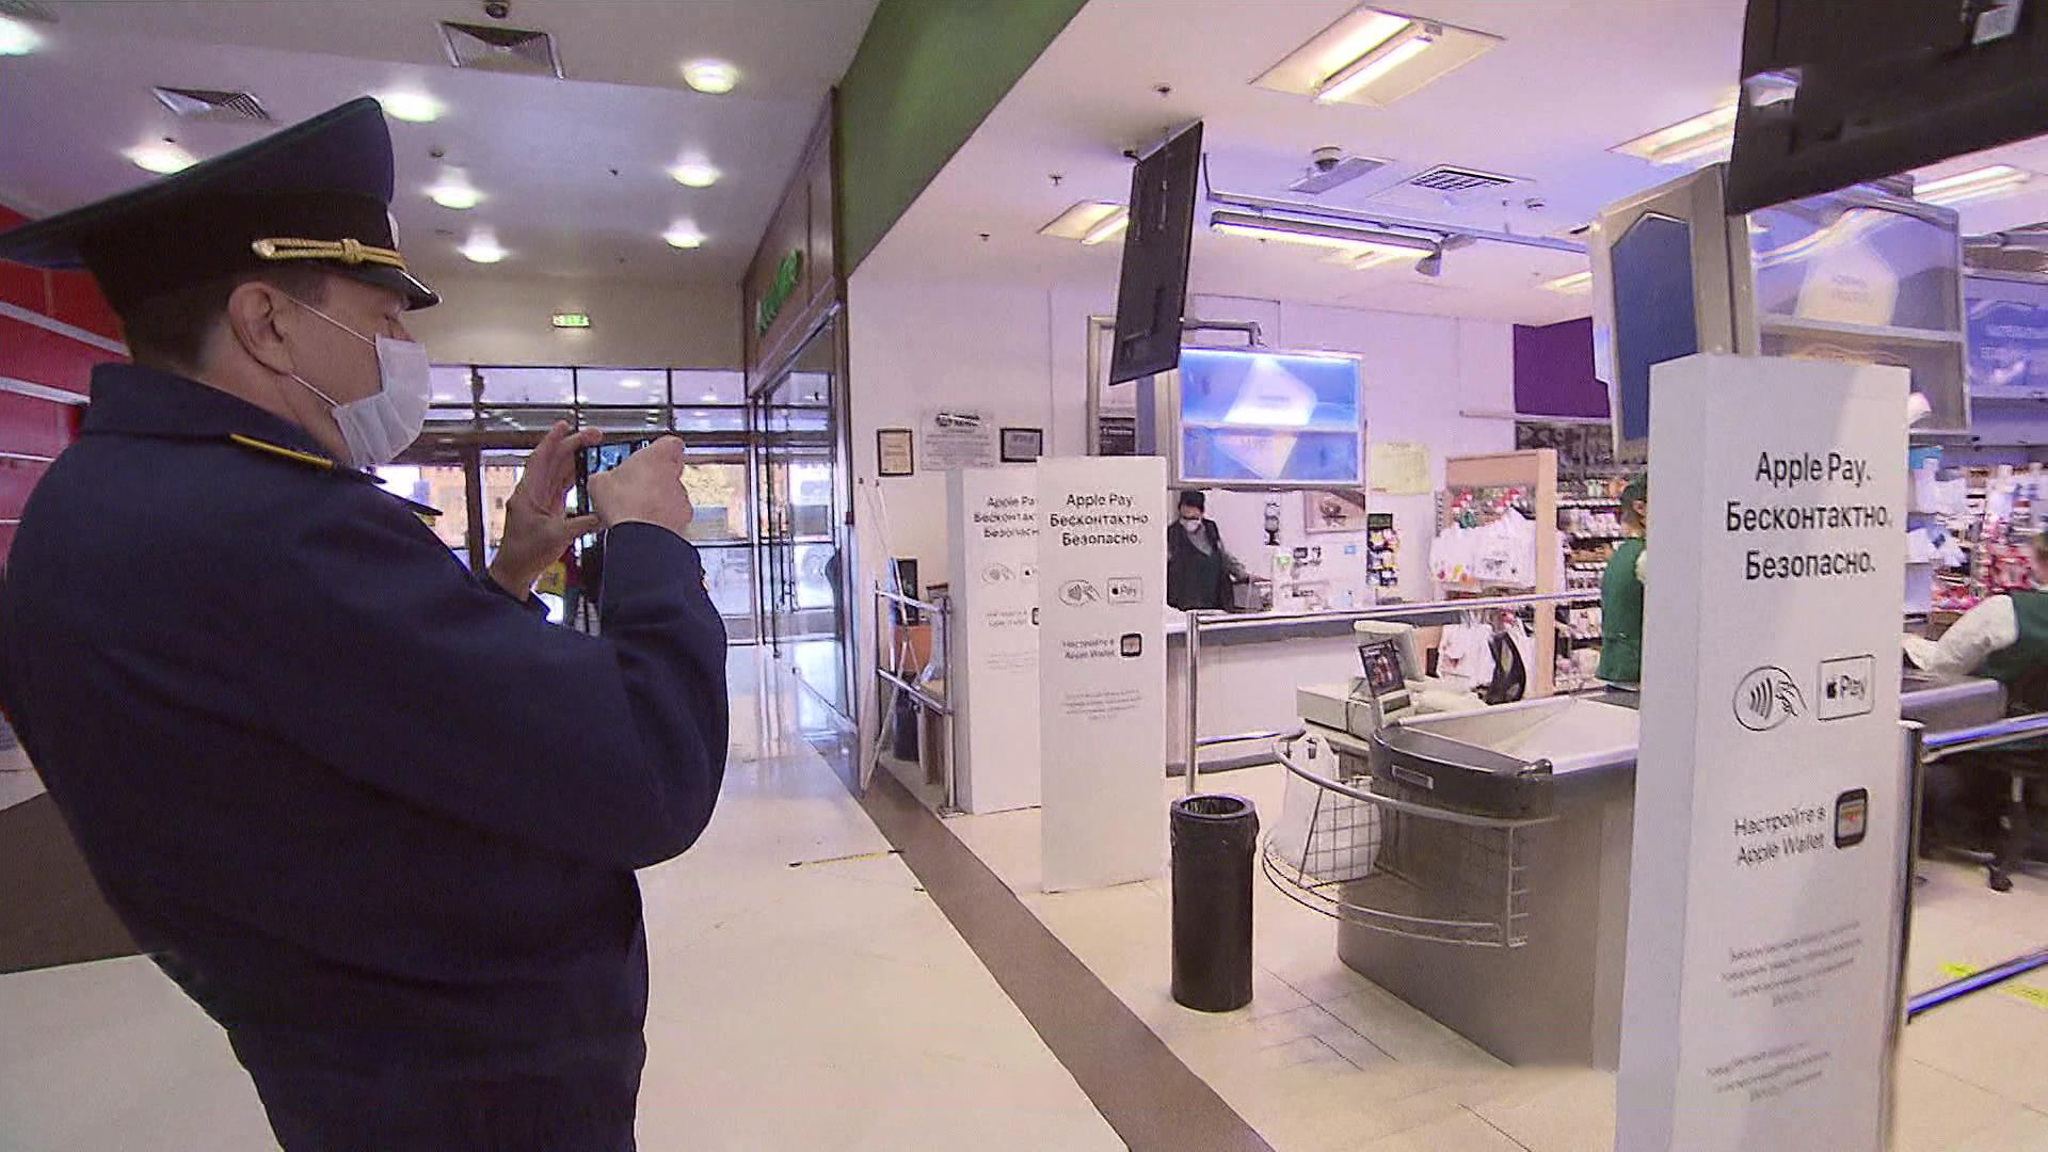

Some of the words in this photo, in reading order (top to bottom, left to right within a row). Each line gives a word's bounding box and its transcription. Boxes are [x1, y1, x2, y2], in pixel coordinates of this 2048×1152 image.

[1755, 451, 1823, 488] Apple
[1828, 452, 1871, 487] Pay.
[1066, 493, 1106, 509] Apple
[1726, 501, 1893, 532] Бесконтактно.
[1745, 550, 1876, 581] Безопасно.
[1840, 674, 1866, 700] Pay
